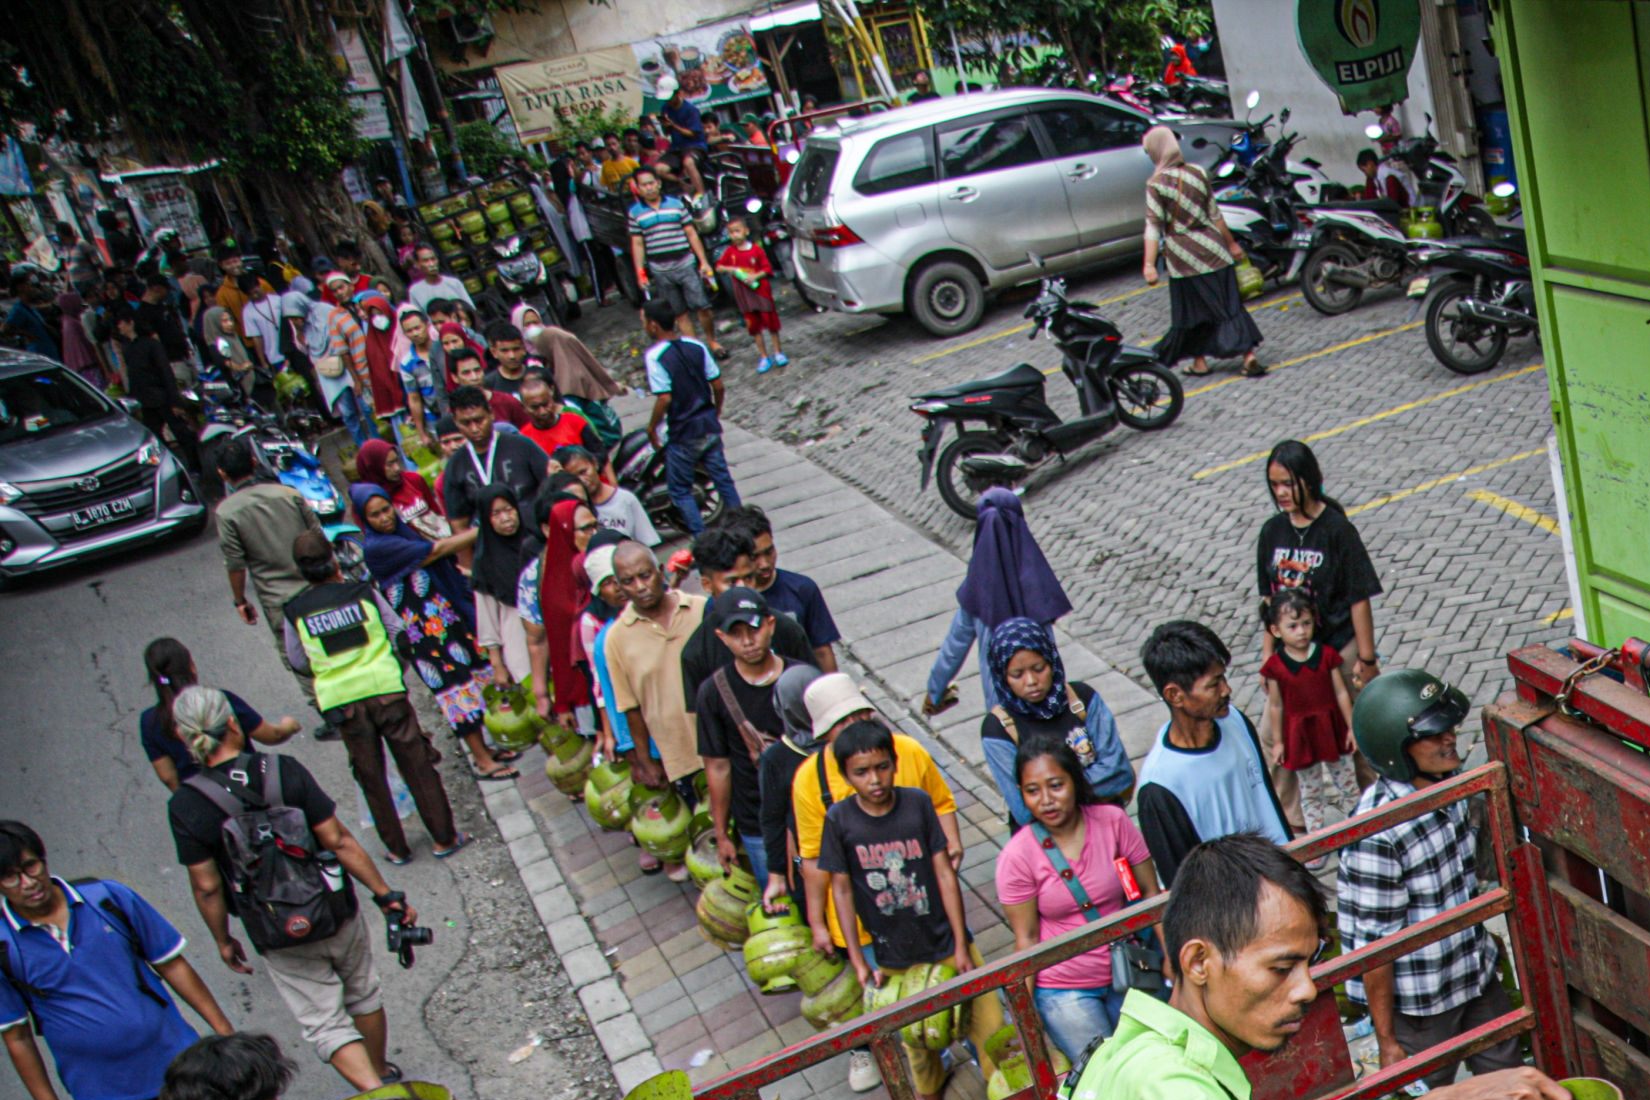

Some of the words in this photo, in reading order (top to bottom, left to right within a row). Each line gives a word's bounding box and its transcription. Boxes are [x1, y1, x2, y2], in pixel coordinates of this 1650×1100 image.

[1338, 51, 1402, 82] ELPIJI
[521, 90, 575, 111] TJITA
[578, 79, 627, 99] RASA
[306, 603, 363, 636] SECURITY
